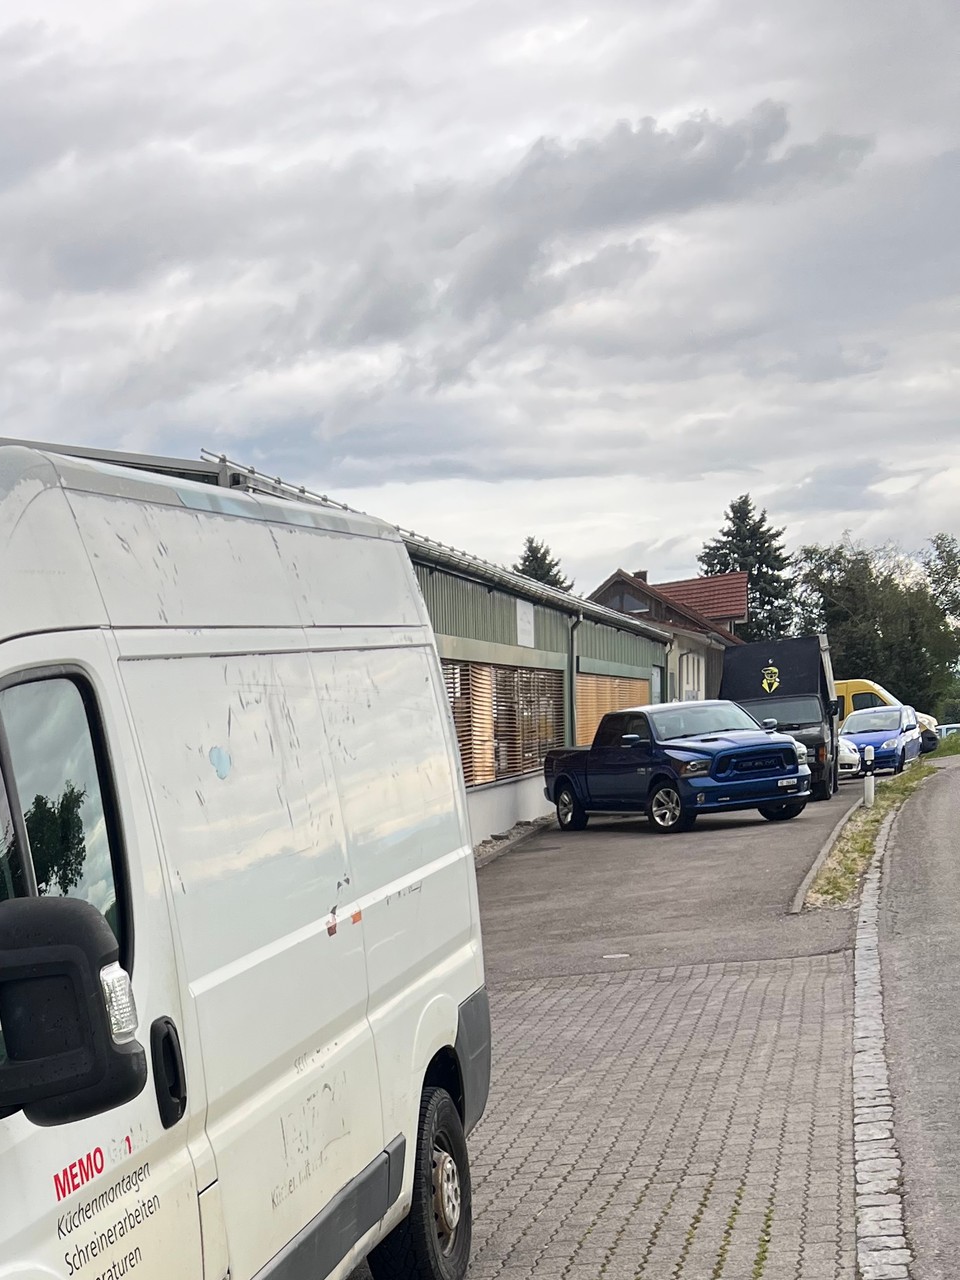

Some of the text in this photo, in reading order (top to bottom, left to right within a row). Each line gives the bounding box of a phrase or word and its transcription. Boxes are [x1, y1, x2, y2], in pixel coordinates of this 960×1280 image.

[53, 1146, 105, 1202] MEMO
[57, 1162, 151, 1241] Küchenmontagen
[64, 1194, 160, 1276] Schreinerarbeiten
